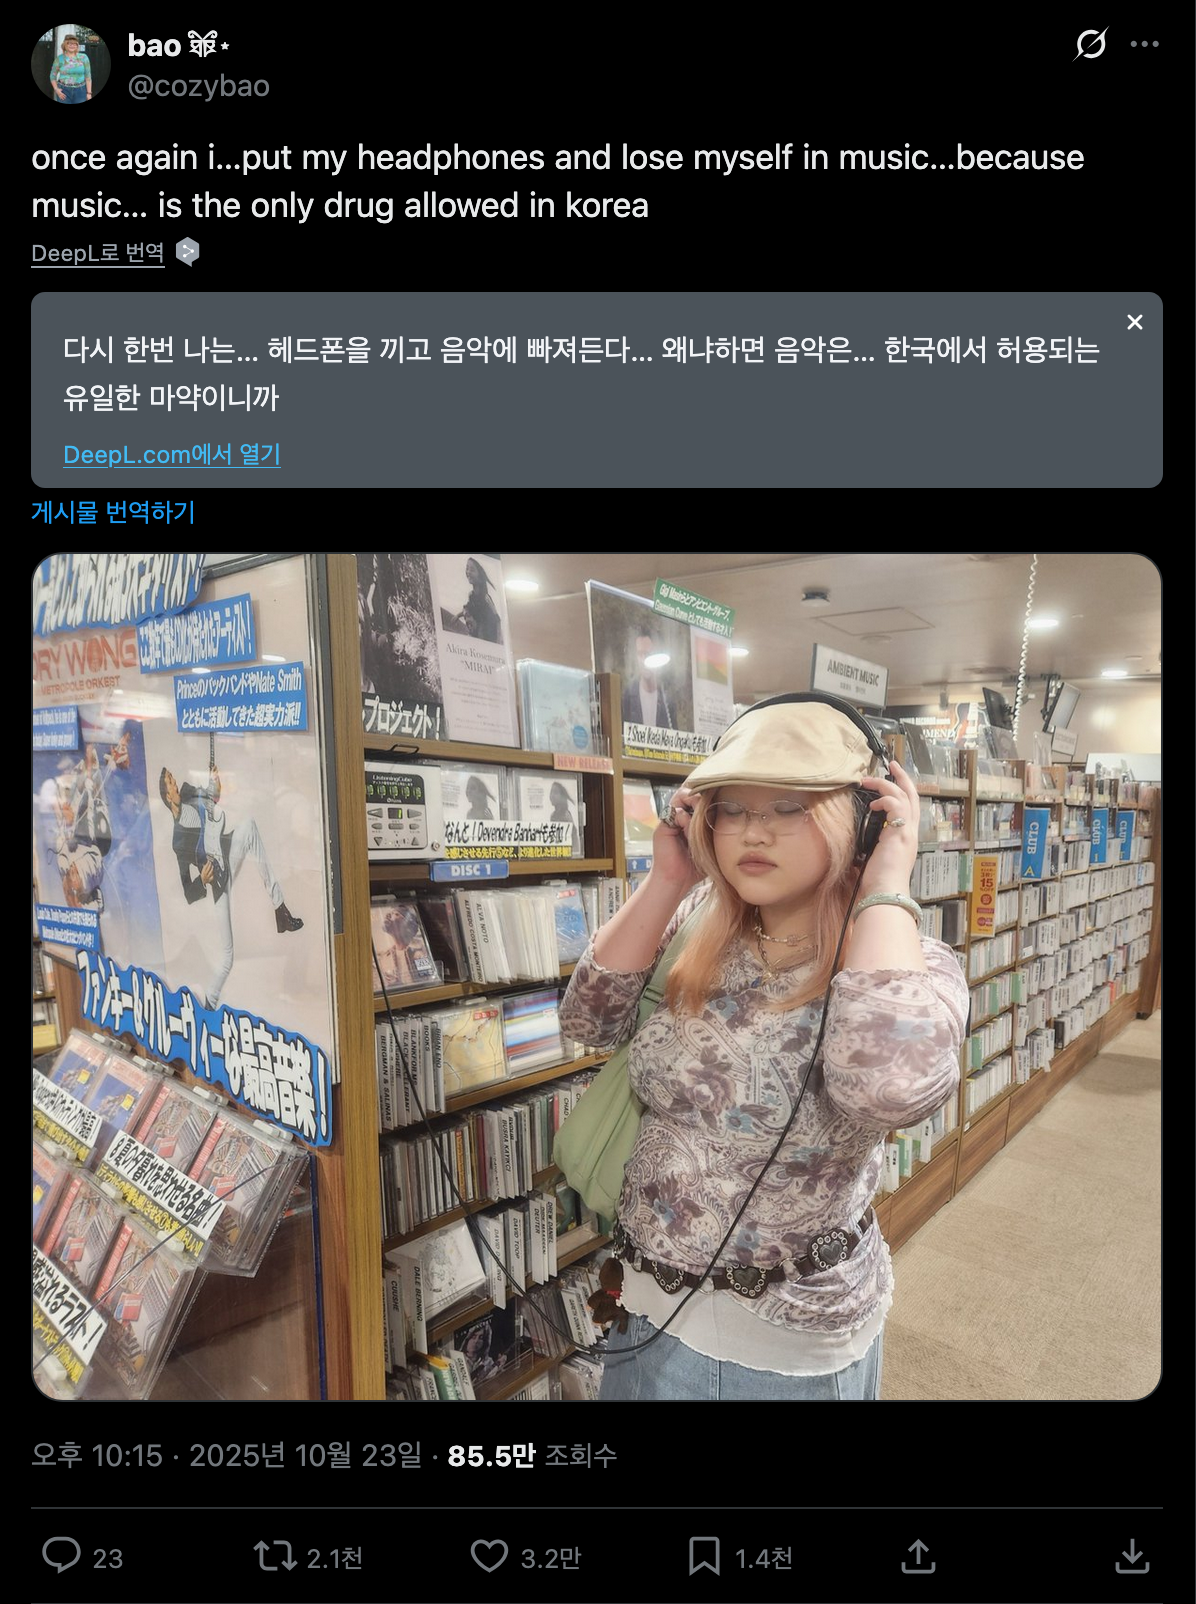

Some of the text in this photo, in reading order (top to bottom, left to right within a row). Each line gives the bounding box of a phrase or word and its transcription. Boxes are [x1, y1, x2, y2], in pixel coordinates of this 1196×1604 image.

[64, 629, 137, 675] WONG
[446, 643, 468, 657] Akira
[86, 676, 120, 688] ORKEST
[278, 667, 302, 692] Smith
[827, 659, 880, 687] AMBIENT MUSIC
[363, 695, 441, 740] プロジェクト!
[557, 755, 577, 768] NEW
[1092, 819, 1101, 845] CLUB
[1024, 822, 1039, 876] CLUB A
[451, 863, 492, 876] DISC 1
[981, 878, 993, 887] 15
[476, 903, 489, 943] ALVA NOTO
[391, 1280, 399, 1312] CUUSHE
[415, 1288, 423, 1321] BERNING
